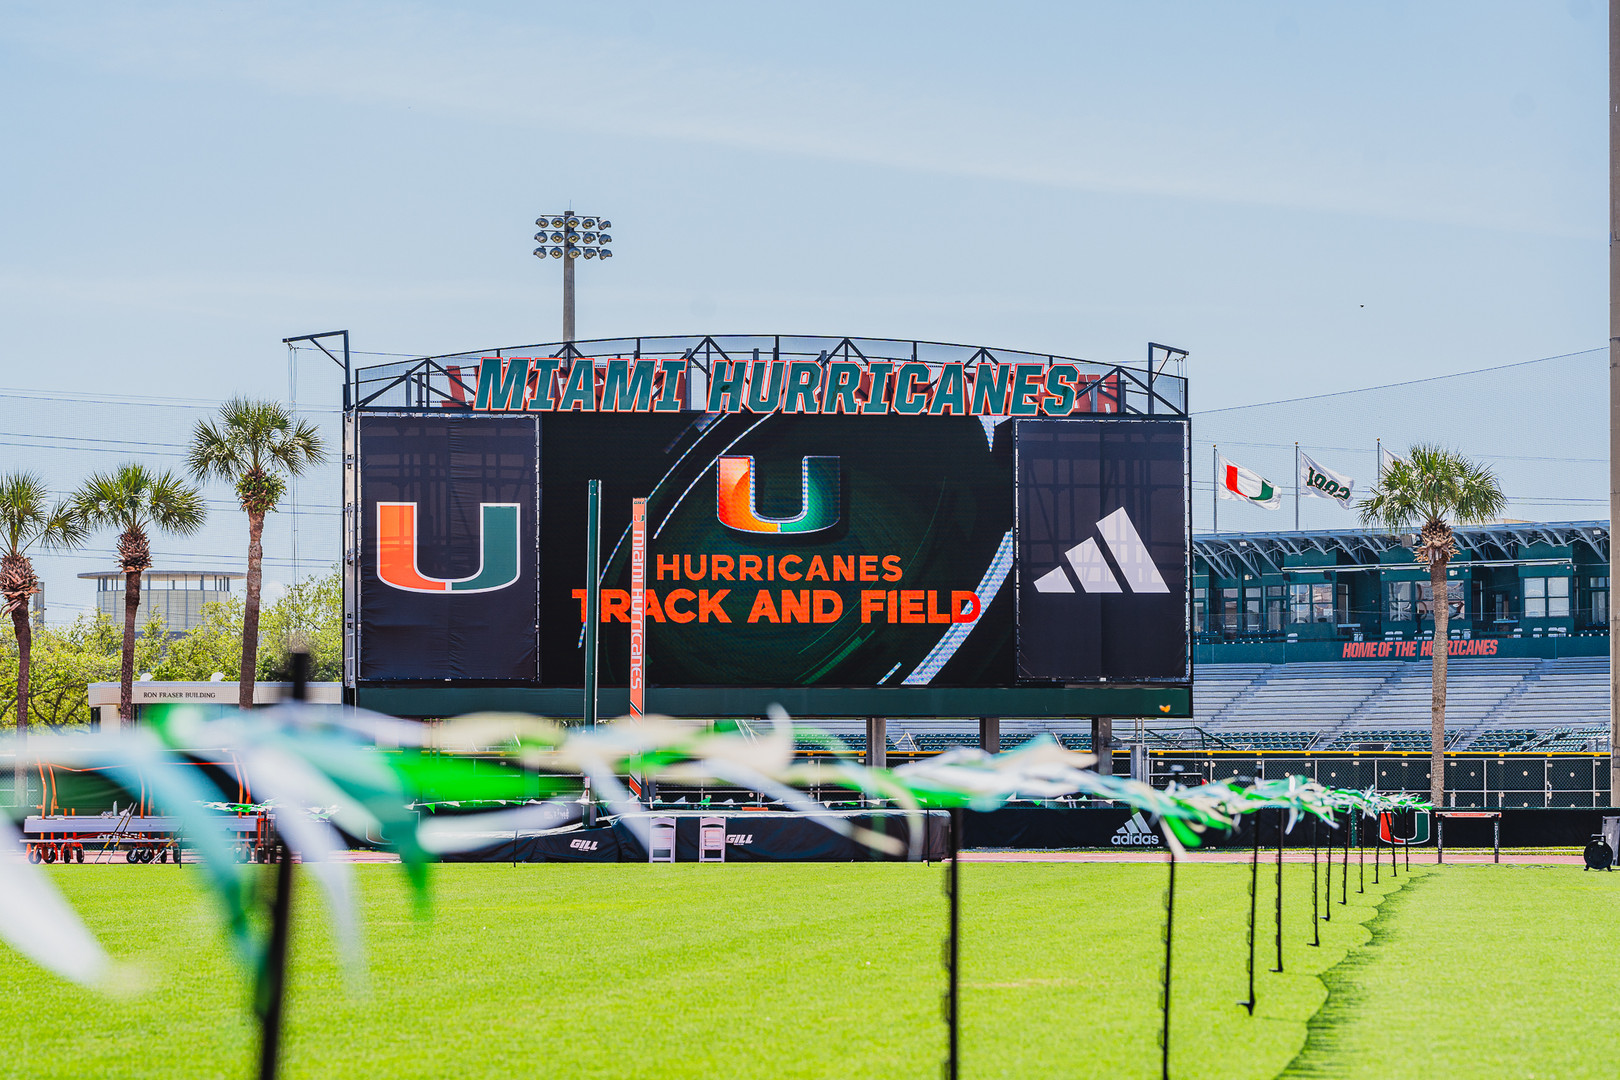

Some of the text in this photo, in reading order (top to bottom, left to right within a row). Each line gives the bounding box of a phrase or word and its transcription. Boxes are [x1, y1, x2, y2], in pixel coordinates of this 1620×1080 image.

[472, 356, 1081, 417] MIAMI HURRICANES
[376, 501, 521, 594] U
[656, 554, 904, 582] HURRICANES
[572, 588, 982, 624] TRACK AND FIELD
[1342, 639, 1499, 658] HOME OF THE HURICANES
[569, 838, 599, 851] GILL
[725, 834, 753, 844] GILL
[1110, 832, 1160, 845] adidas
